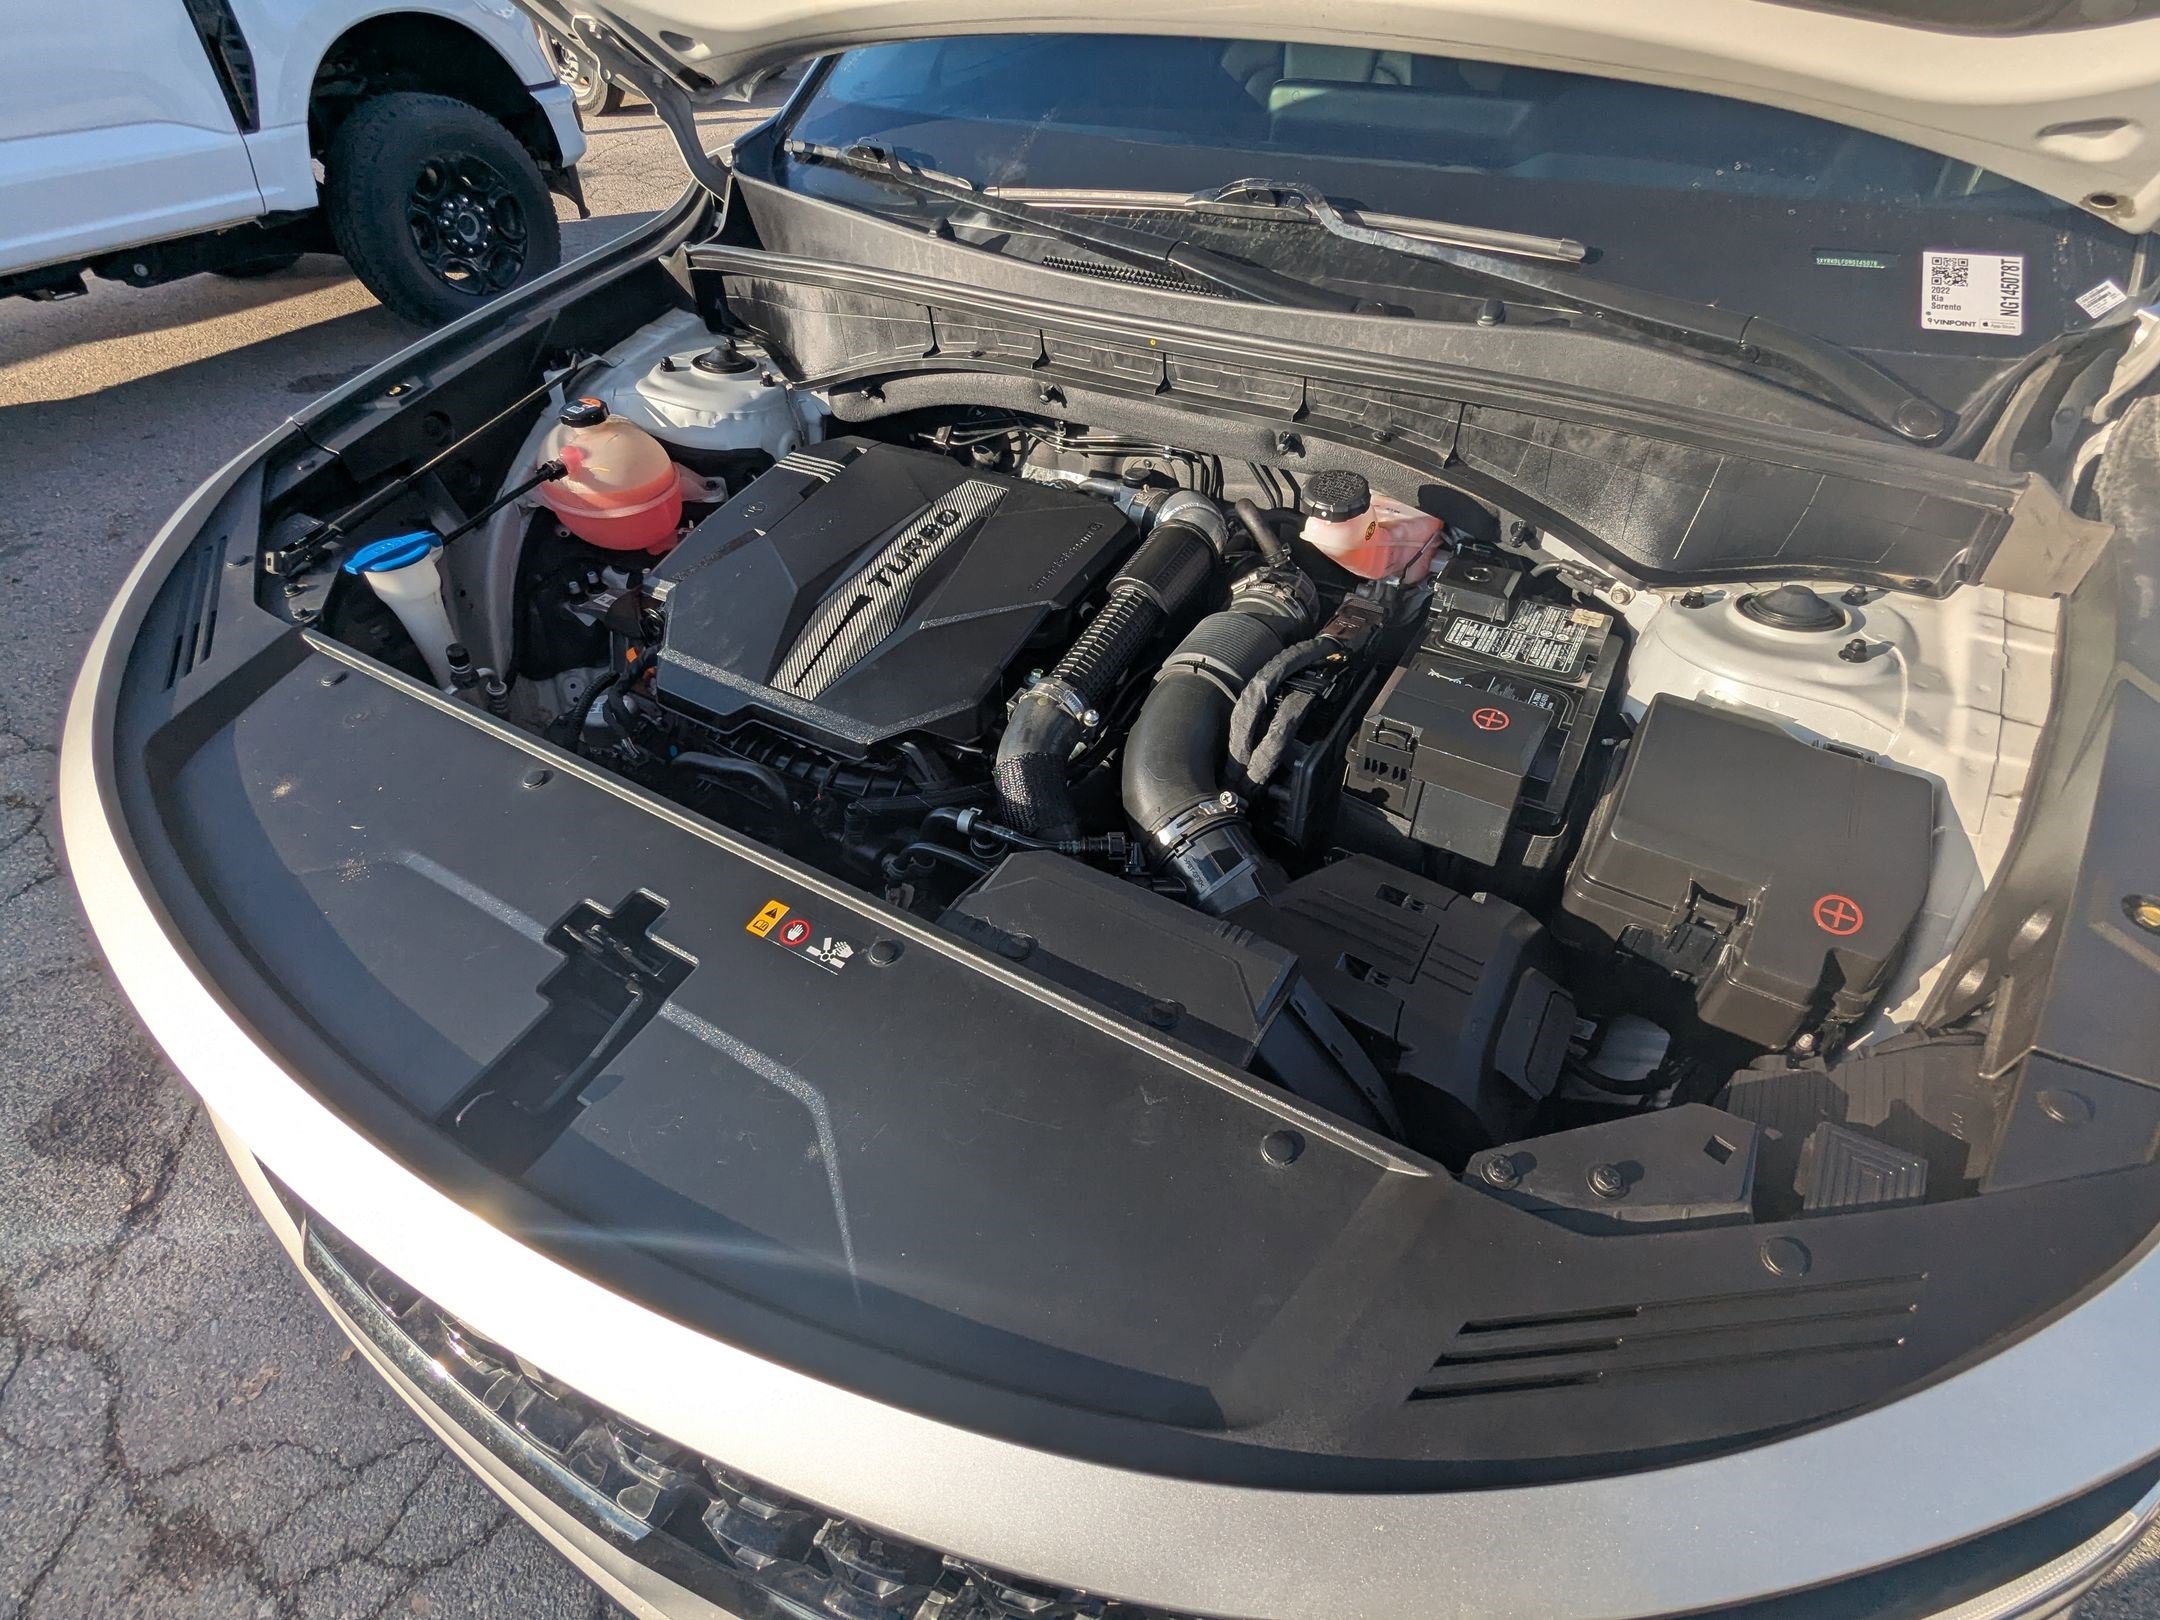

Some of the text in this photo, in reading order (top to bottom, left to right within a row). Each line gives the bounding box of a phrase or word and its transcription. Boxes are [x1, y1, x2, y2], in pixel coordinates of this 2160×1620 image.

[1931, 286, 1950, 295] 2022
[2000, 258, 2020, 317] NG145078T
[1931, 294, 1944, 302] Kia
[1931, 302, 1962, 311] Sorento
[1933, 319, 1977, 328] VINPOINT
[867, 509, 961, 588] TURBO
